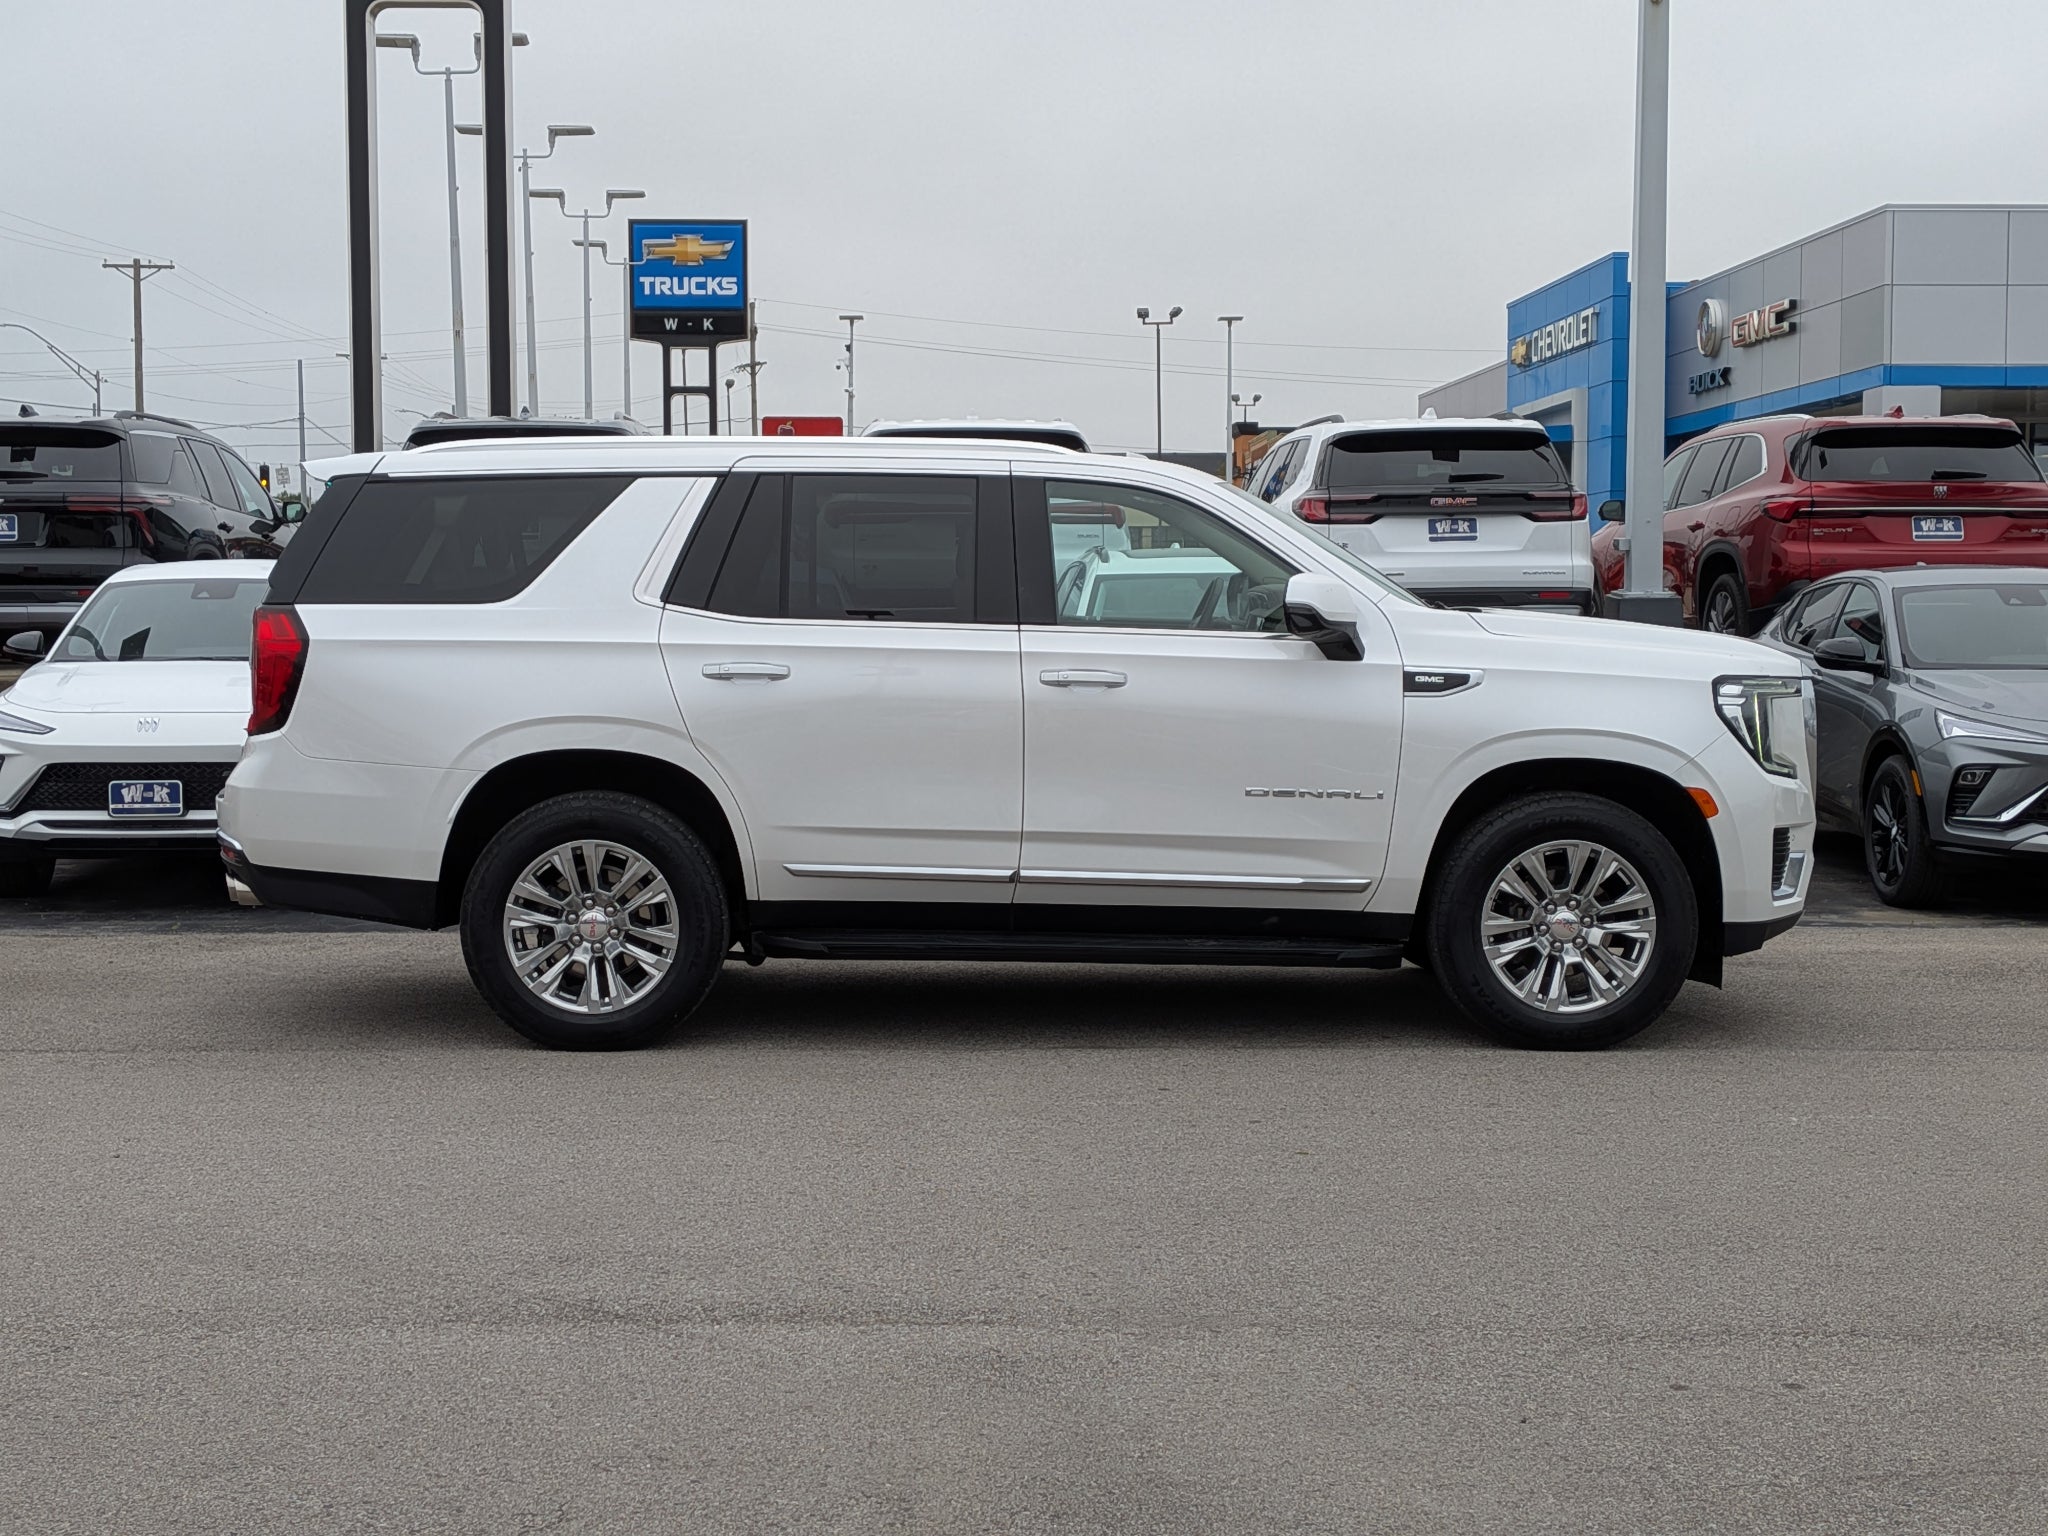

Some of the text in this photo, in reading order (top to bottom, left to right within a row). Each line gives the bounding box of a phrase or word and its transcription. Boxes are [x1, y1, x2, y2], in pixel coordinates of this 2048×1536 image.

[639, 276, 738, 296] TRUCKS
[1731, 299, 1793, 347] GMC
[1531, 306, 1599, 363] CHEVROLET
[1689, 367, 1730, 395] BUICK
[1430, 497, 1478, 507] GMC
[1435, 519, 1471, 533] W-K
[1920, 518, 1955, 532] W-K
[1415, 675, 1445, 683] GMC
[121, 784, 171, 804] W-K
[1244, 786, 1384, 800] DENALI
